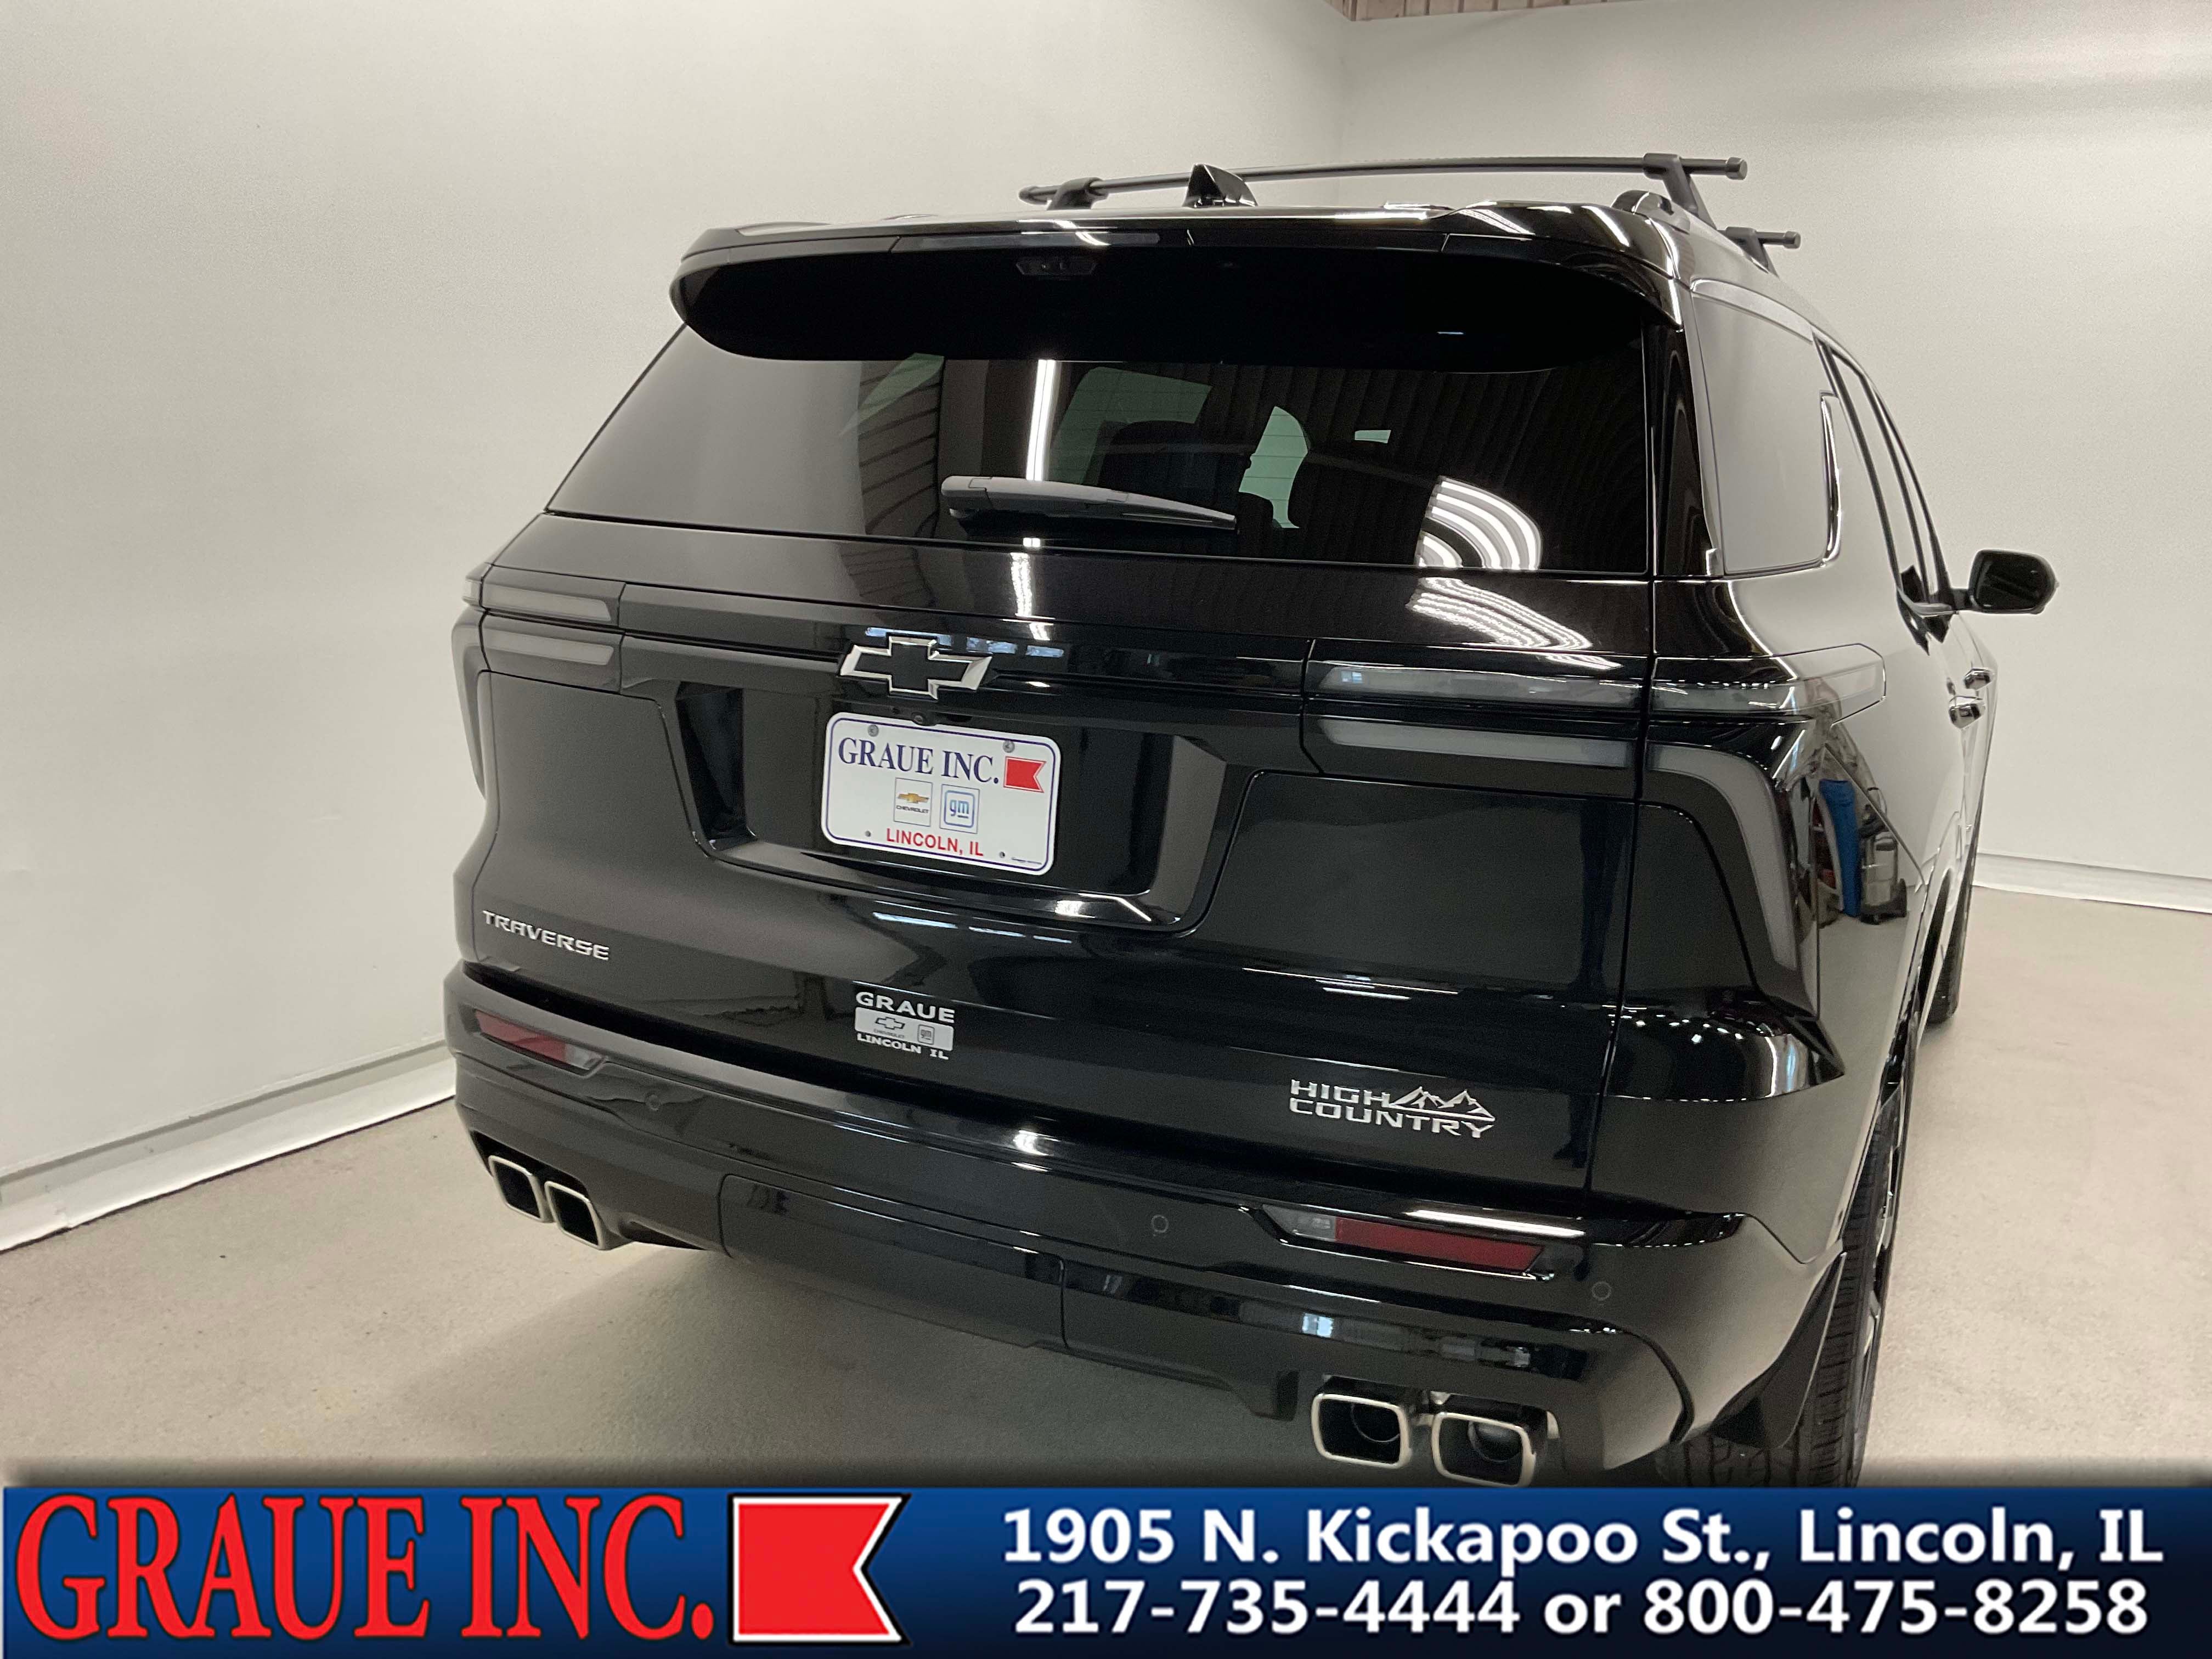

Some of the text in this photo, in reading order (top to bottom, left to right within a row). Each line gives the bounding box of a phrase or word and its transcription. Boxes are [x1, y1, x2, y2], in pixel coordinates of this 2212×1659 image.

[838, 737, 1000, 785] GRAUE INC.
[896, 805, 929, 814] CHEVROLET
[949, 799, 969, 817] gm
[886, 828, 984, 857] LINCOLN, IL
[483, 910, 610, 960] TRAVERSE
[856, 991, 955, 1023] GRAUE
[857, 1032, 949, 1060] LINCOLN IL
[1290, 1079, 1390, 1108] HIGH
[1289, 1097, 1494, 1138] COUNTRY
